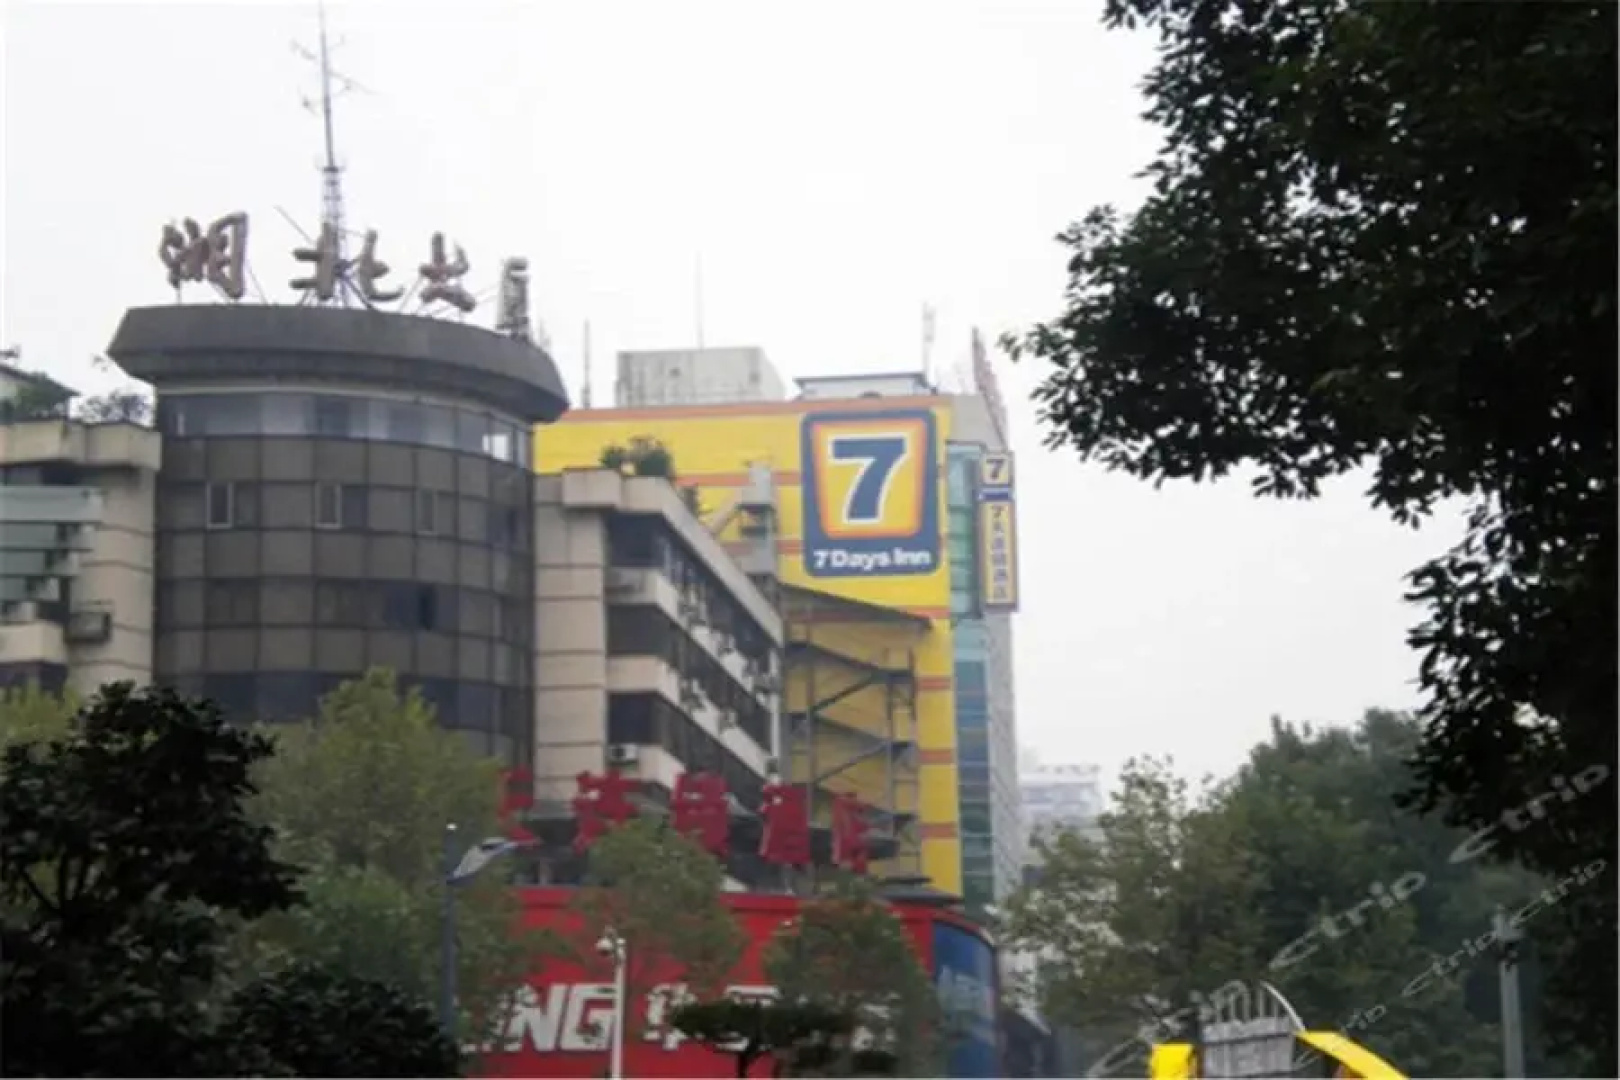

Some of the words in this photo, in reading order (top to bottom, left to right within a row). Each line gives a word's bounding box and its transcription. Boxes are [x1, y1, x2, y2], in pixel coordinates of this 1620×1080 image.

[829, 433, 908, 523] 7
[985, 457, 1006, 480] 7
[831, 549, 890, 571] Days
[893, 547, 932, 566] Inn
